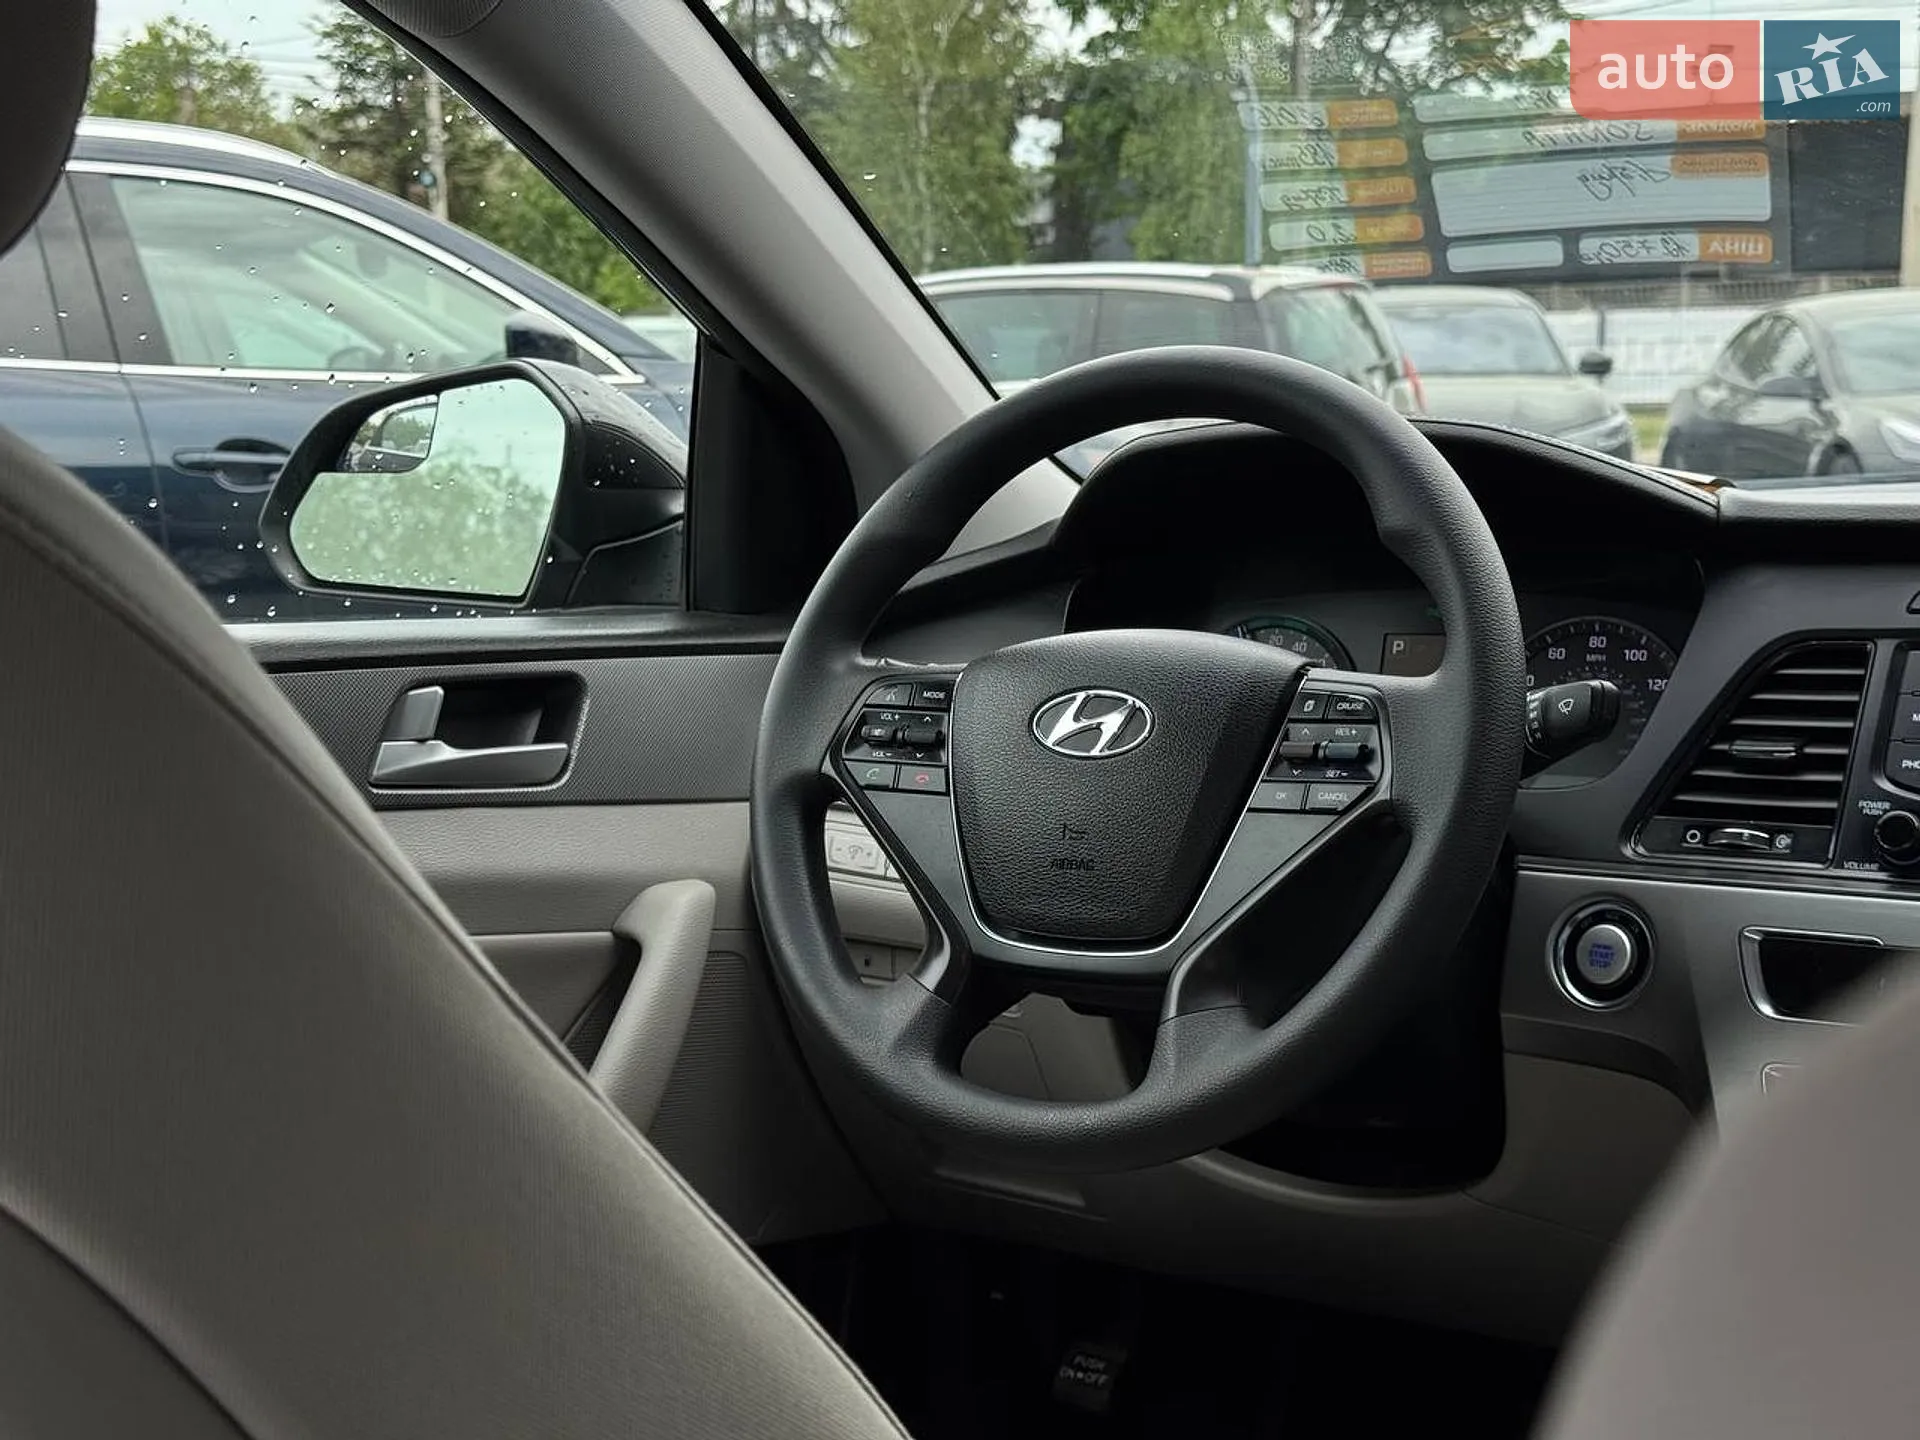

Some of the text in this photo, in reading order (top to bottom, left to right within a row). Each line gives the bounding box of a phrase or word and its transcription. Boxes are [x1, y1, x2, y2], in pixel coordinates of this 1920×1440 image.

[1588, 635, 1608, 648] 80
[1392, 639, 1404, 655] P
[1547, 647, 1567, 660] 60
[1585, 653, 1607, 663] MPH
[1623, 649, 1648, 662] 100
[922, 690, 946, 699] MODE
[1336, 701, 1365, 711] CRUISE
[1858, 800, 1891, 810] POWER
[1843, 861, 1880, 870] VOLUME
